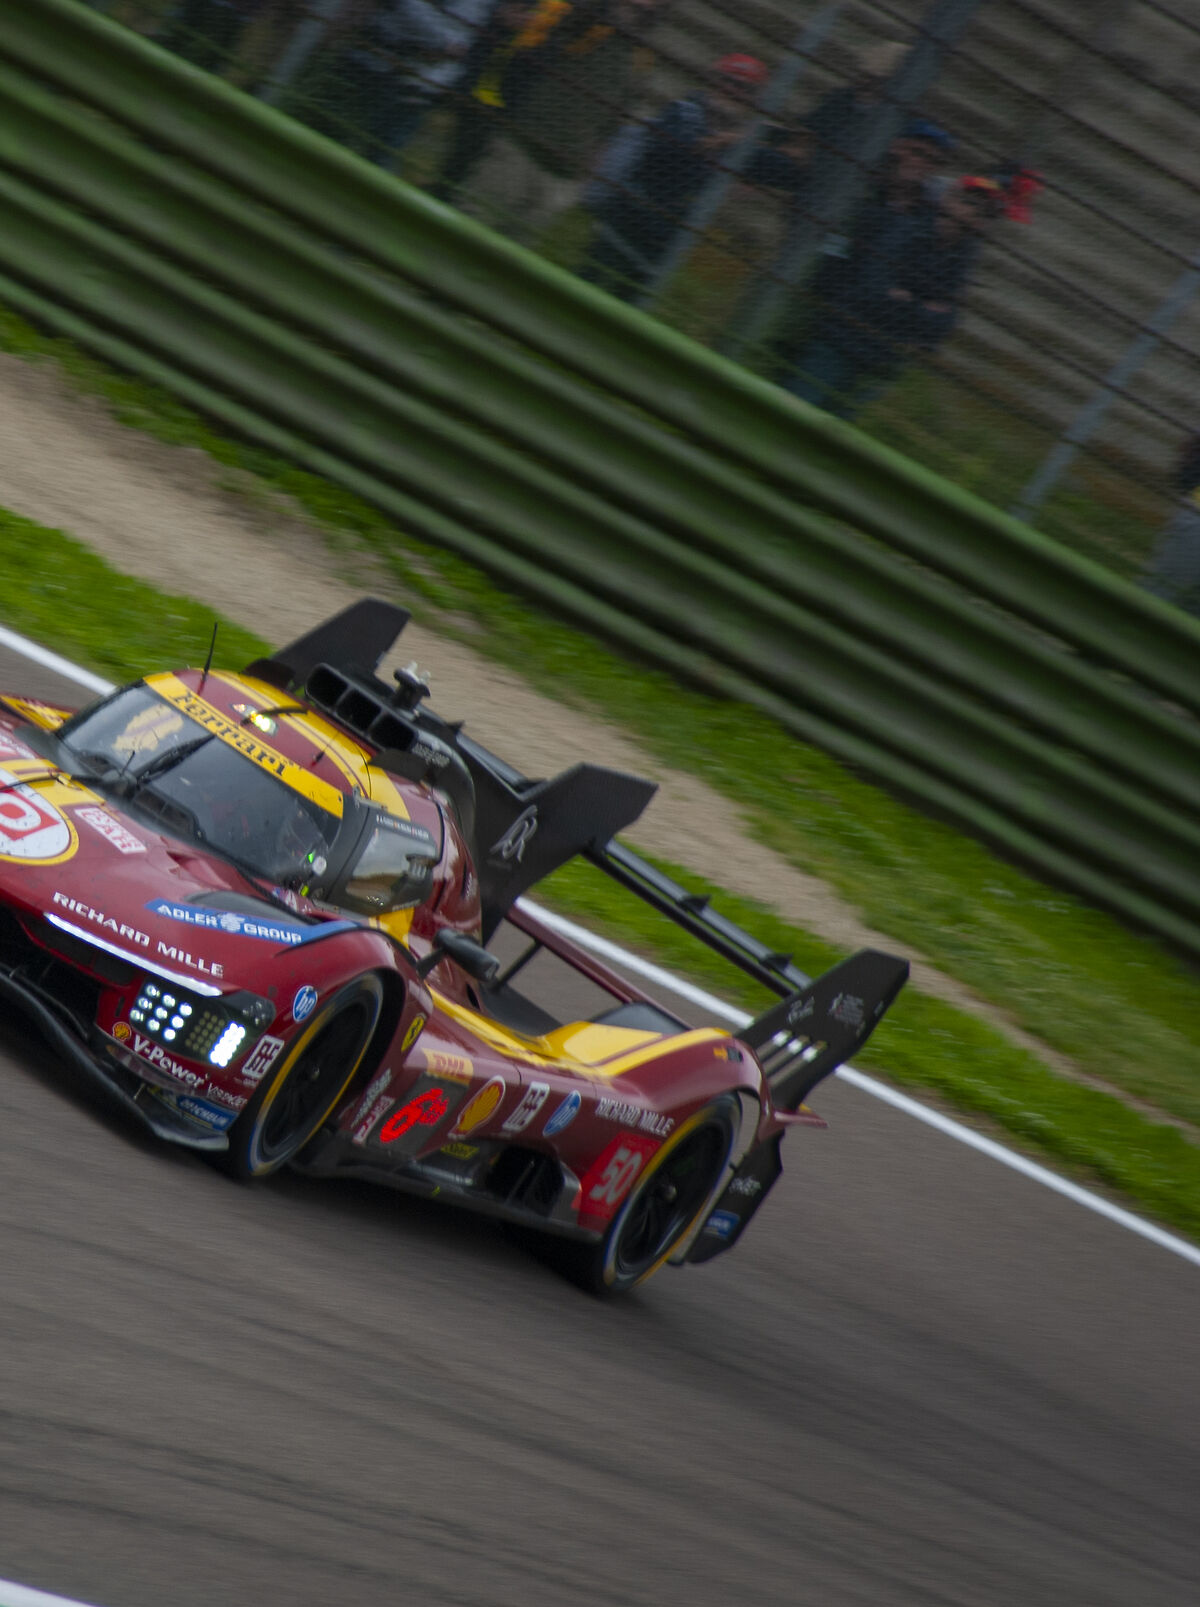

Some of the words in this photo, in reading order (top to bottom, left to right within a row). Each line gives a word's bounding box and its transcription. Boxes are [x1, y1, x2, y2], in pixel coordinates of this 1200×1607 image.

[173, 690, 288, 778] Ferrari
[52, 891, 151, 948] RICHARD
[157, 941, 225, 978] MILLE
[156, 903, 218, 928] ADLER
[243, 922, 303, 944] GROUP
[132, 1034, 205, 1089] V-Power
[595, 1097, 641, 1127] RICHARD
[639, 1109, 675, 1138] MILLE
[590, 1145, 642, 1206] 50
